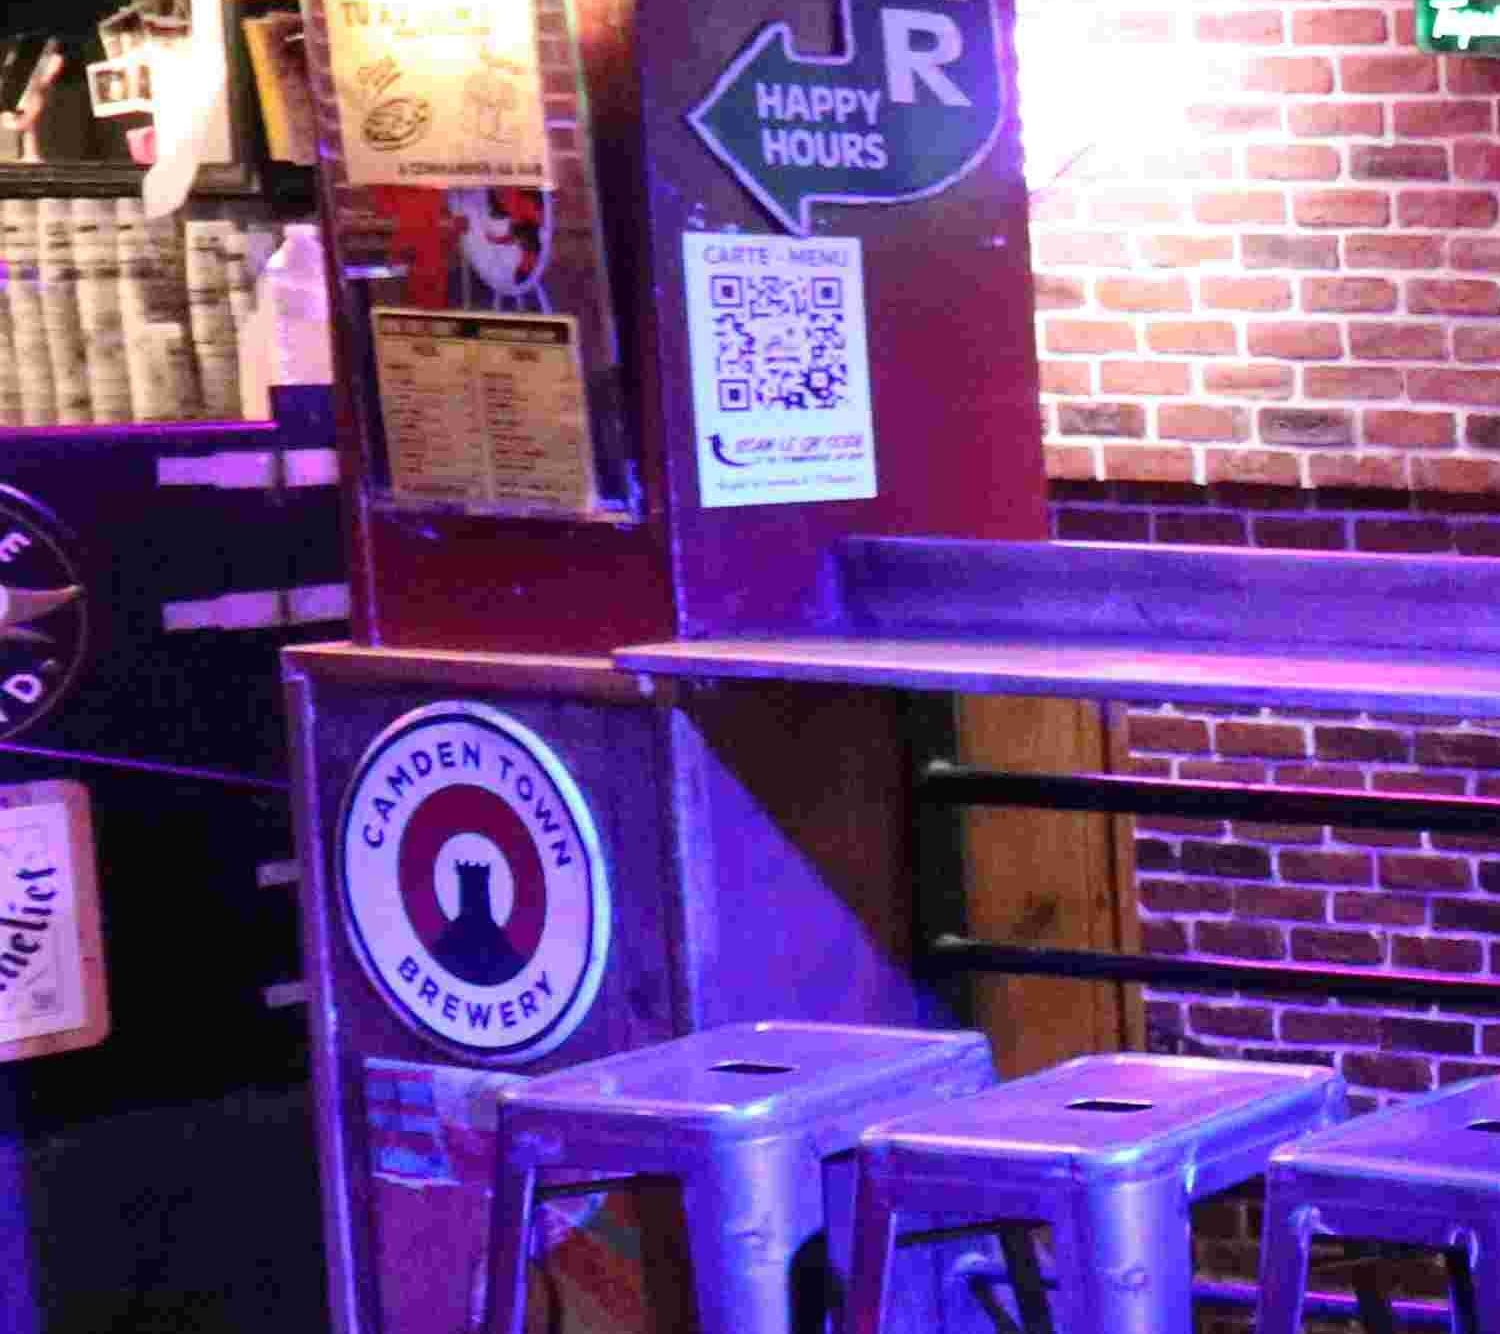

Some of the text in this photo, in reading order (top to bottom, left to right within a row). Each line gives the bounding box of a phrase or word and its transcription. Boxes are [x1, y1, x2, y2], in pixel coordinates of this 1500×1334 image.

[755, 81, 880, 126] HAPPY
[762, 127, 888, 170] HOURS
[361, 740, 574, 869] CAMDEN TOWN
[396, 955, 554, 1030] BREWERY
